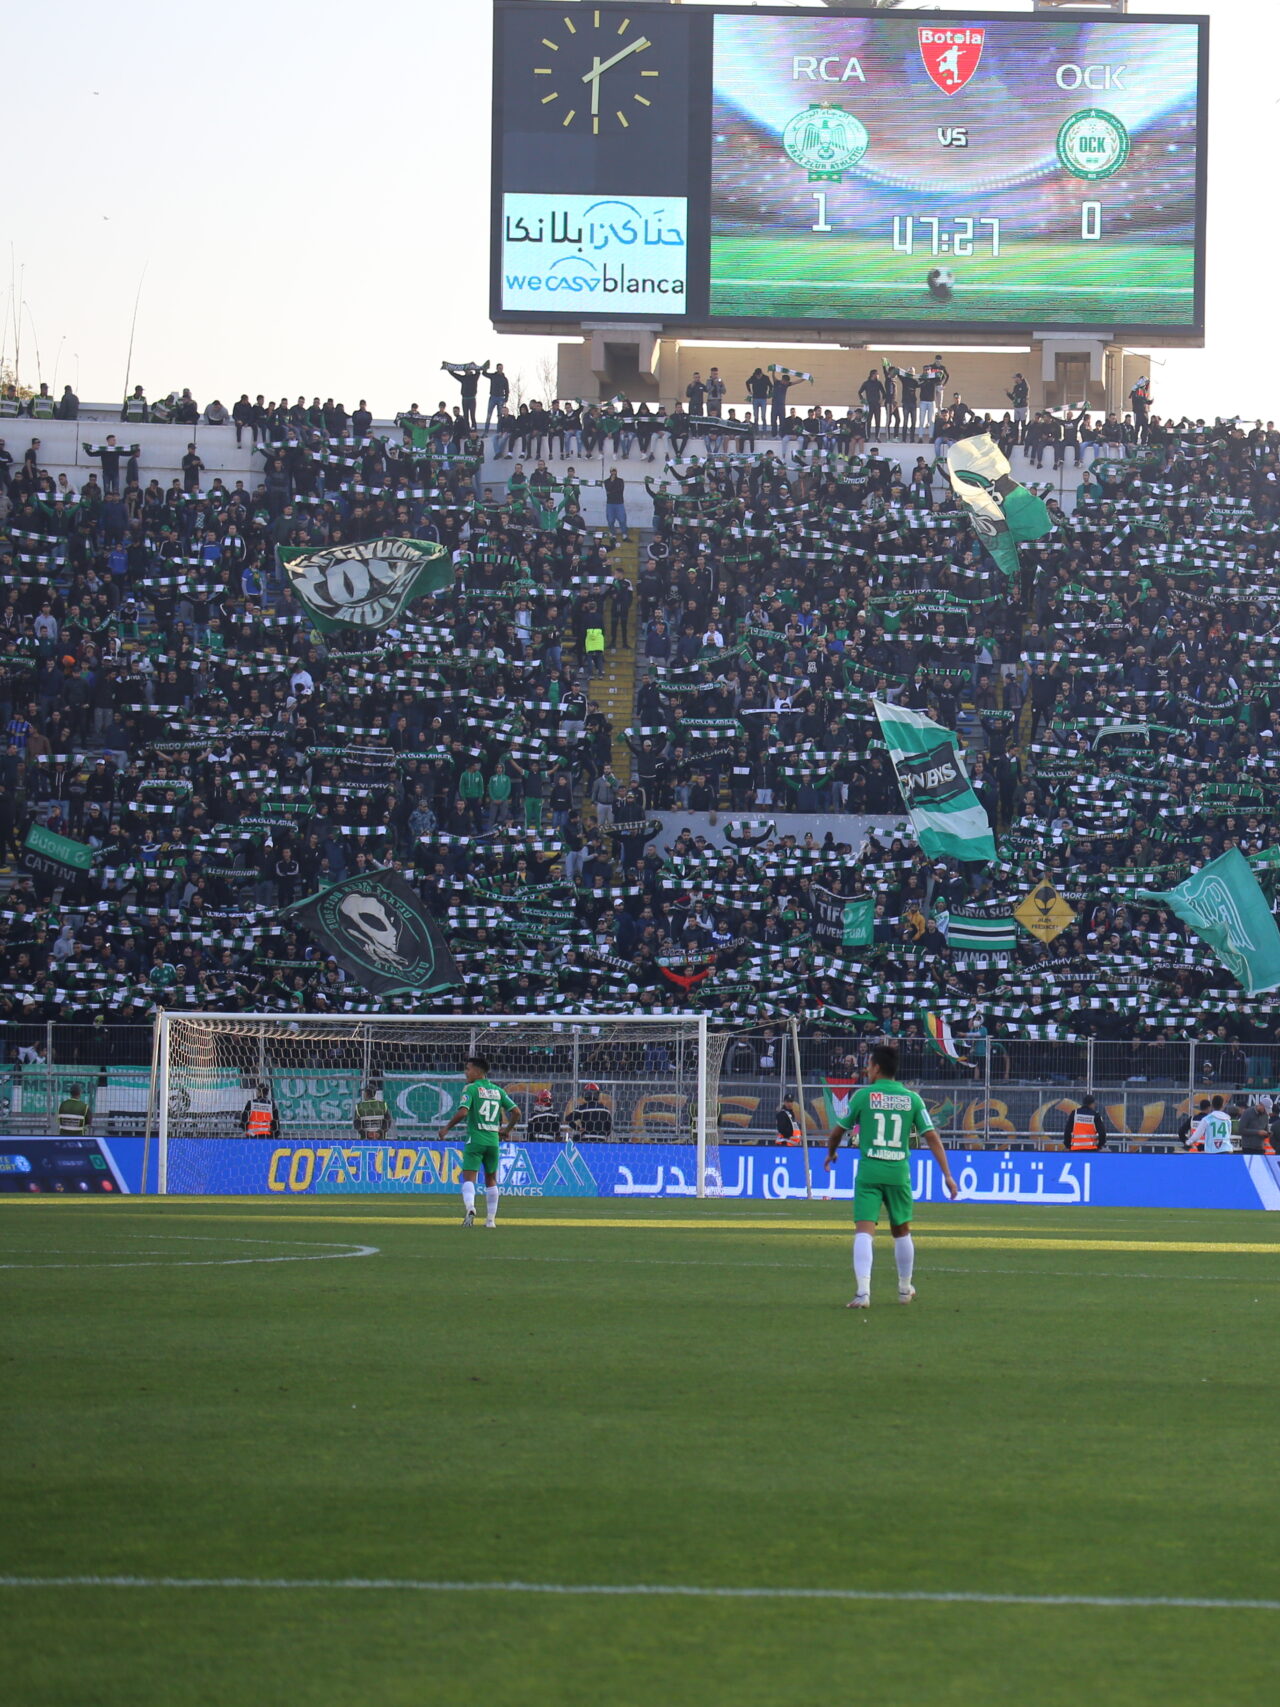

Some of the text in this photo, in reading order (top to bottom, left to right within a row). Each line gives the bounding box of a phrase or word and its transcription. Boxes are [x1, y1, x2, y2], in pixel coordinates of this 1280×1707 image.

[921, 30, 982, 45] Botola
[792, 55, 867, 83] RCA
[1055, 64, 1127, 91] OCK
[937, 126, 969, 148] VS
[1080, 136, 1106, 153] OCK
[811, 192, 833, 232] 1
[1081, 200, 1102, 240] 0
[891, 214, 1001, 258] 47:27
[817, 901, 854, 925] TIFO
[950, 903, 1012, 919] CURVA SUD
[951, 950, 989, 962] SIAMO
[478, 1099, 500, 1122] 47
[872, 1112, 903, 1149] 11
[1209, 1121, 1229, 1138] 14
[318, 1144, 539, 1186] ATLANA
